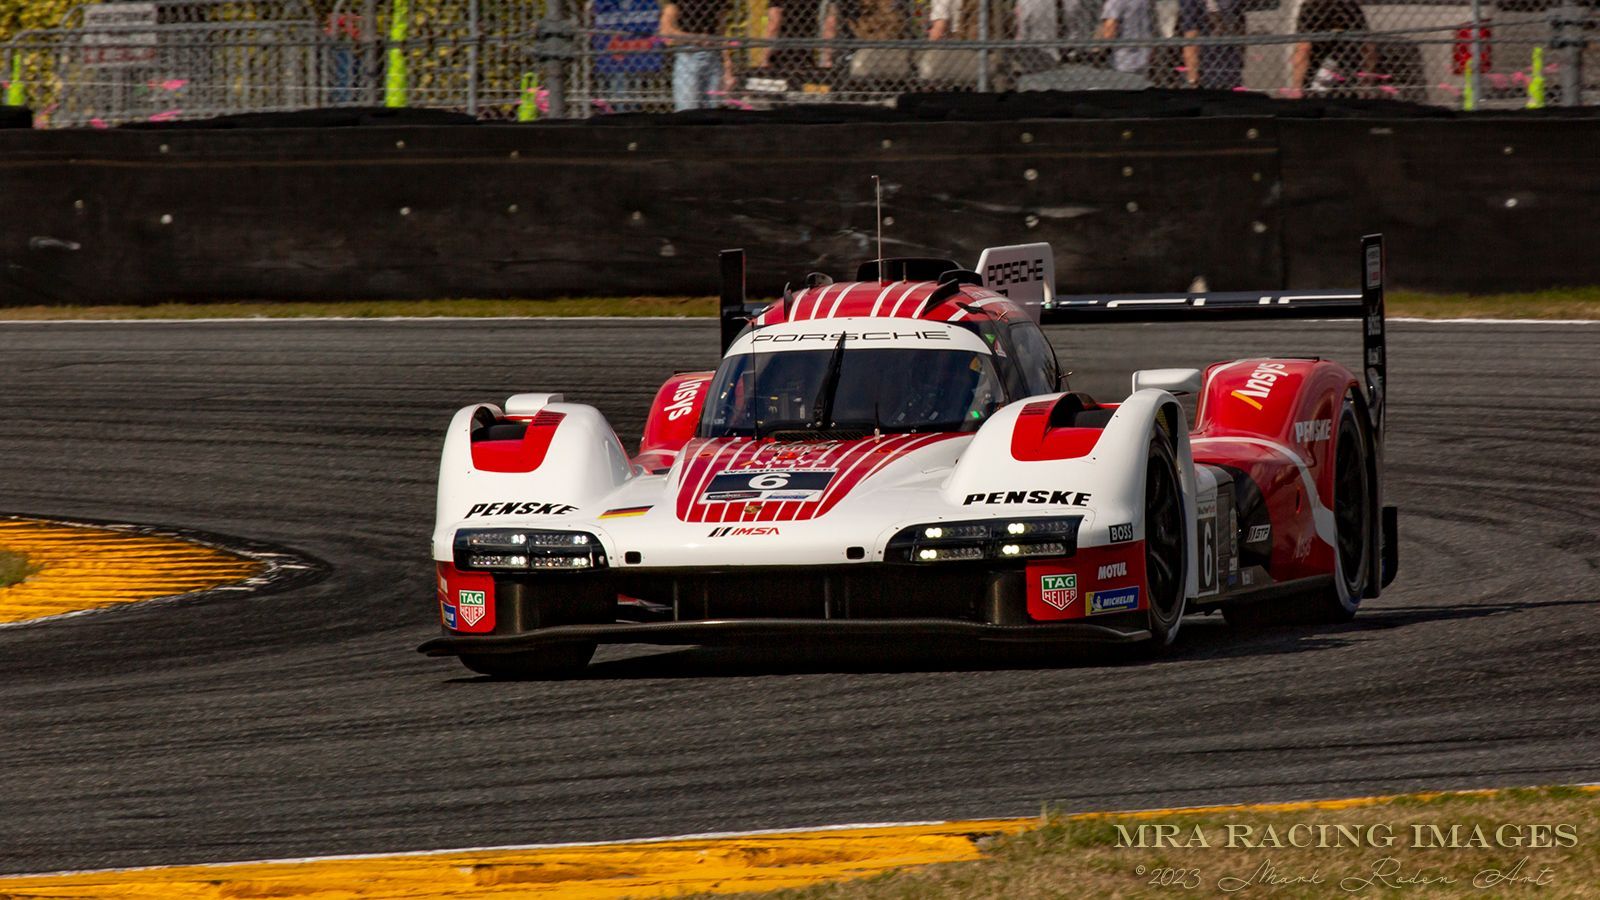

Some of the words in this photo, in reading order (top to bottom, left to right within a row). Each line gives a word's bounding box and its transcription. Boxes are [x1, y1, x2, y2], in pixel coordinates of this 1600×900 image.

[987, 259, 1043, 287] PORSCHE
[751, 330, 950, 344] PORSCHE
[1231, 363, 1288, 411] Ansys
[1295, 419, 1332, 443] PENSKE
[748, 473, 791, 490] 6
[963, 491, 1092, 506] PENSKE
[464, 502, 579, 519] PENSKE
[731, 527, 780, 536] IMSA
[1111, 525, 1132, 541] BOSS
[1204, 522, 1213, 587] 6
[1098, 562, 1127, 580] MOTUL
[1045, 576, 1074, 588] TAG
[461, 592, 482, 604] TAG
[1044, 590, 1075, 608] HEUER
[1103, 594, 1135, 607] MICHELIN
[460, 606, 483, 623] HEUER
